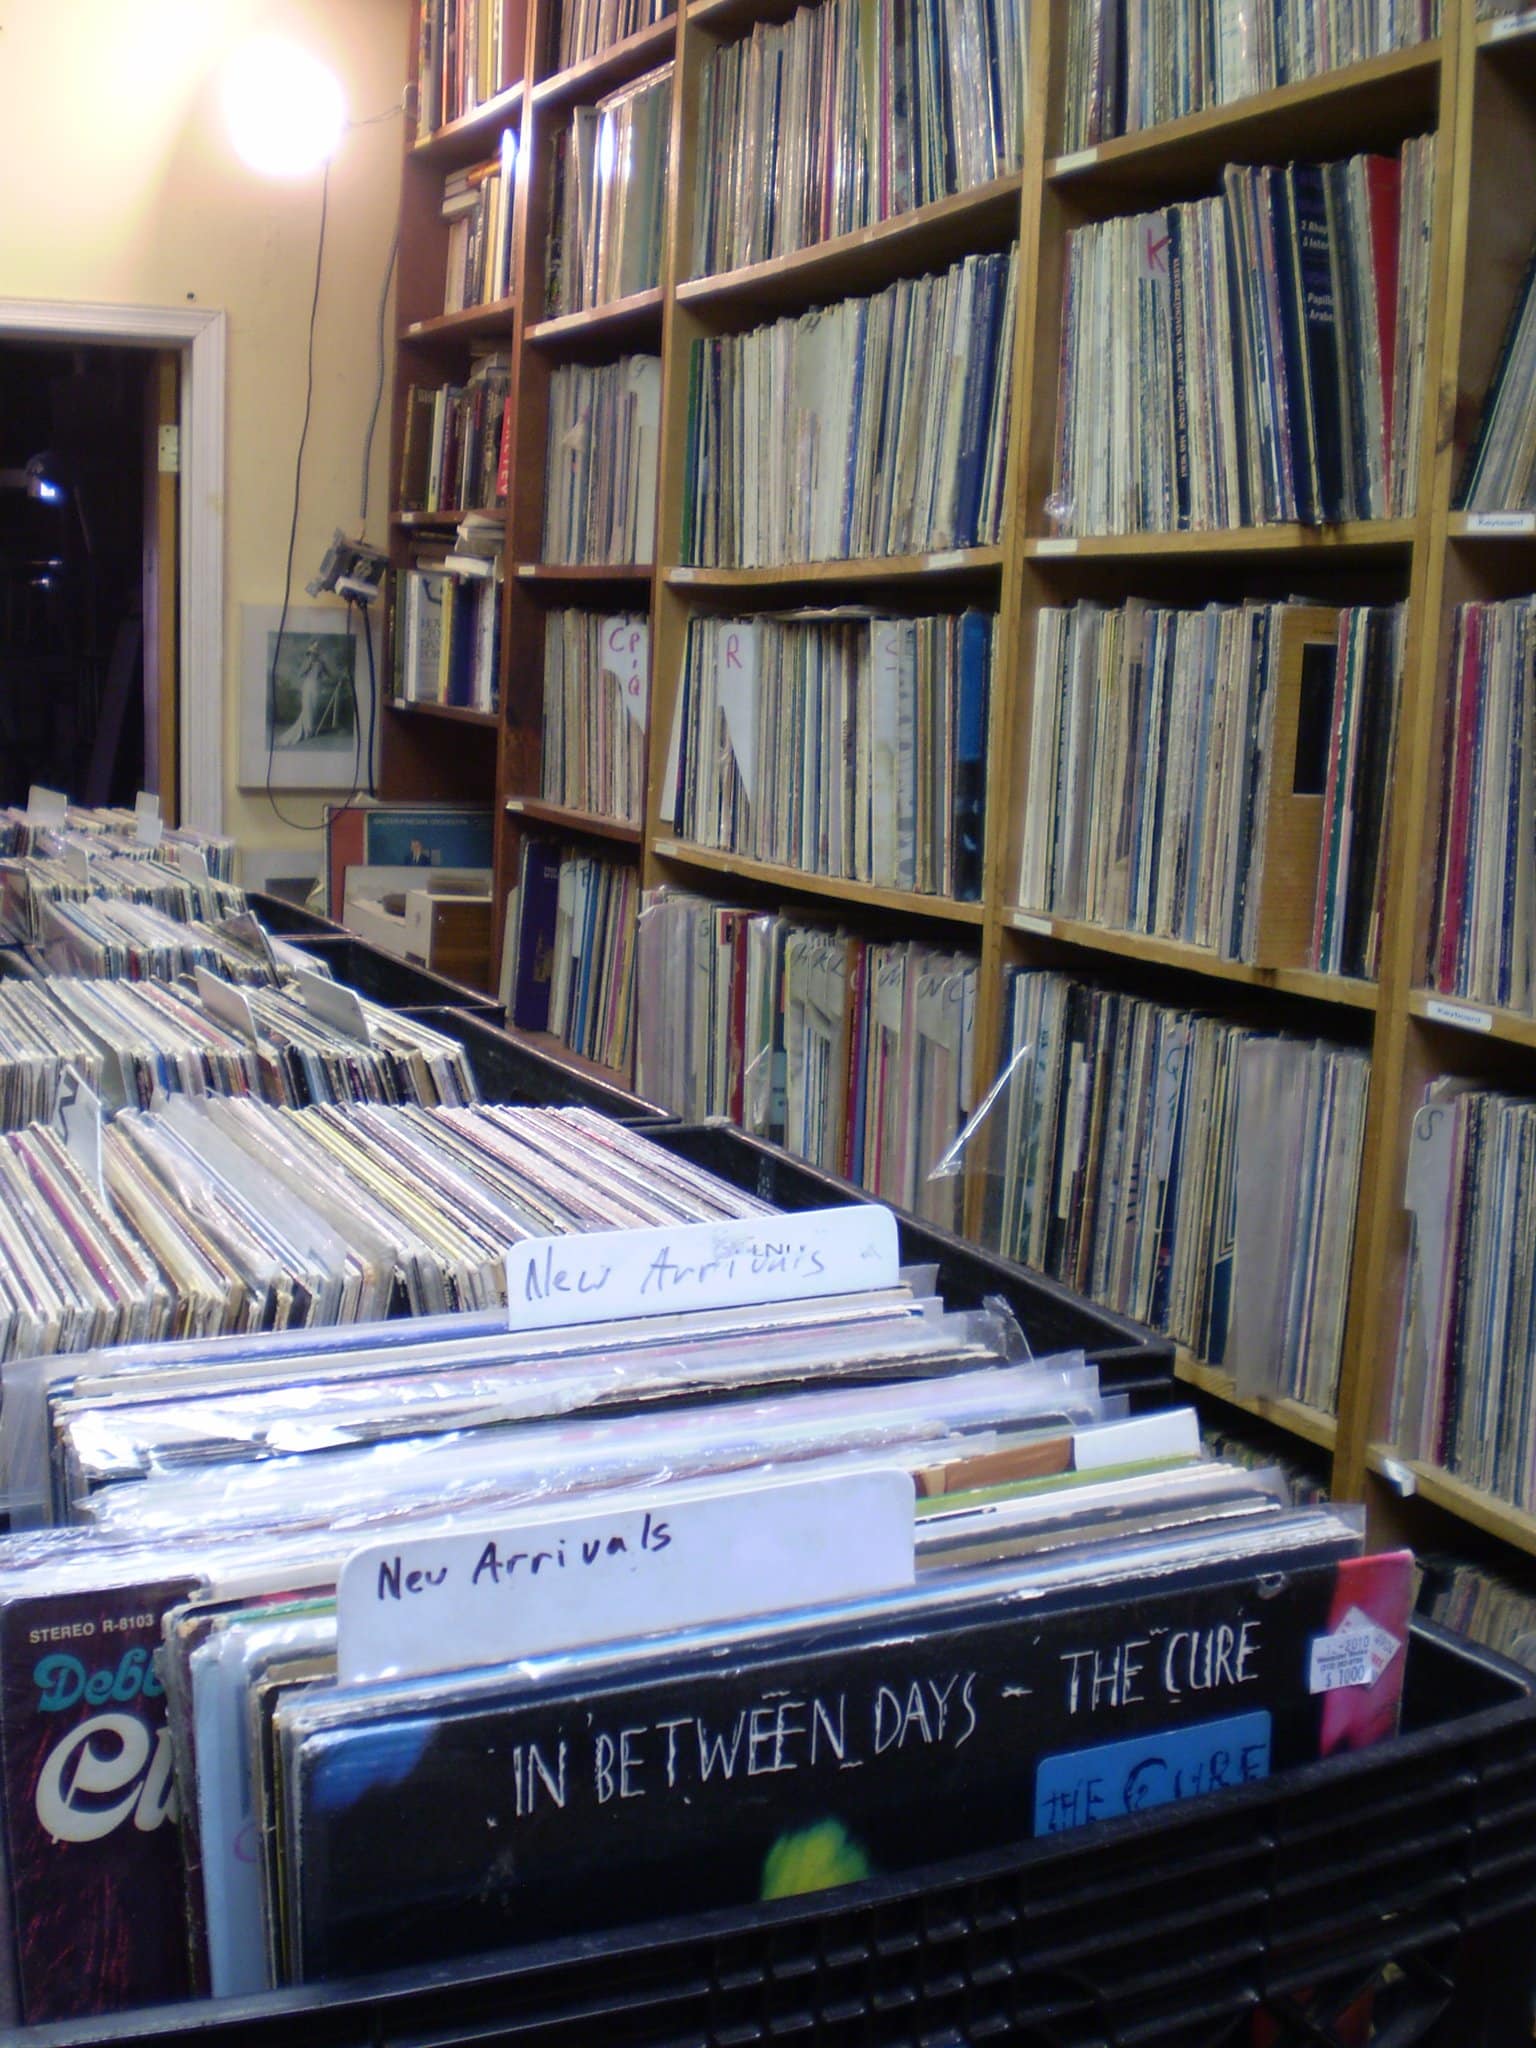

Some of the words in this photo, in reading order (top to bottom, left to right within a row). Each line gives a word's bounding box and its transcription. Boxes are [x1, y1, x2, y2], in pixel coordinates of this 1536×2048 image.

[1147, 228, 1171, 273] K
[726, 633, 743, 669] R
[1417, 1110, 1444, 1142] S
[525, 1245, 610, 1301] New
[640, 1246, 826, 1295] Arrivals
[377, 1556, 448, 1601] New
[471, 1512, 672, 1585] Arrivals
[29, 1622, 96, 1644] STEREO
[102, 1613, 155, 1634] R-8103
[512, 1738, 566, 1817] IN
[594, 1692, 848, 1804] BETWEEN
[874, 1671, 977, 1755] DAYS
[1060, 1640, 1151, 1715] THE
[1164, 1621, 1262, 1694] CURE
[1122, 1744, 1267, 1813] CURE
